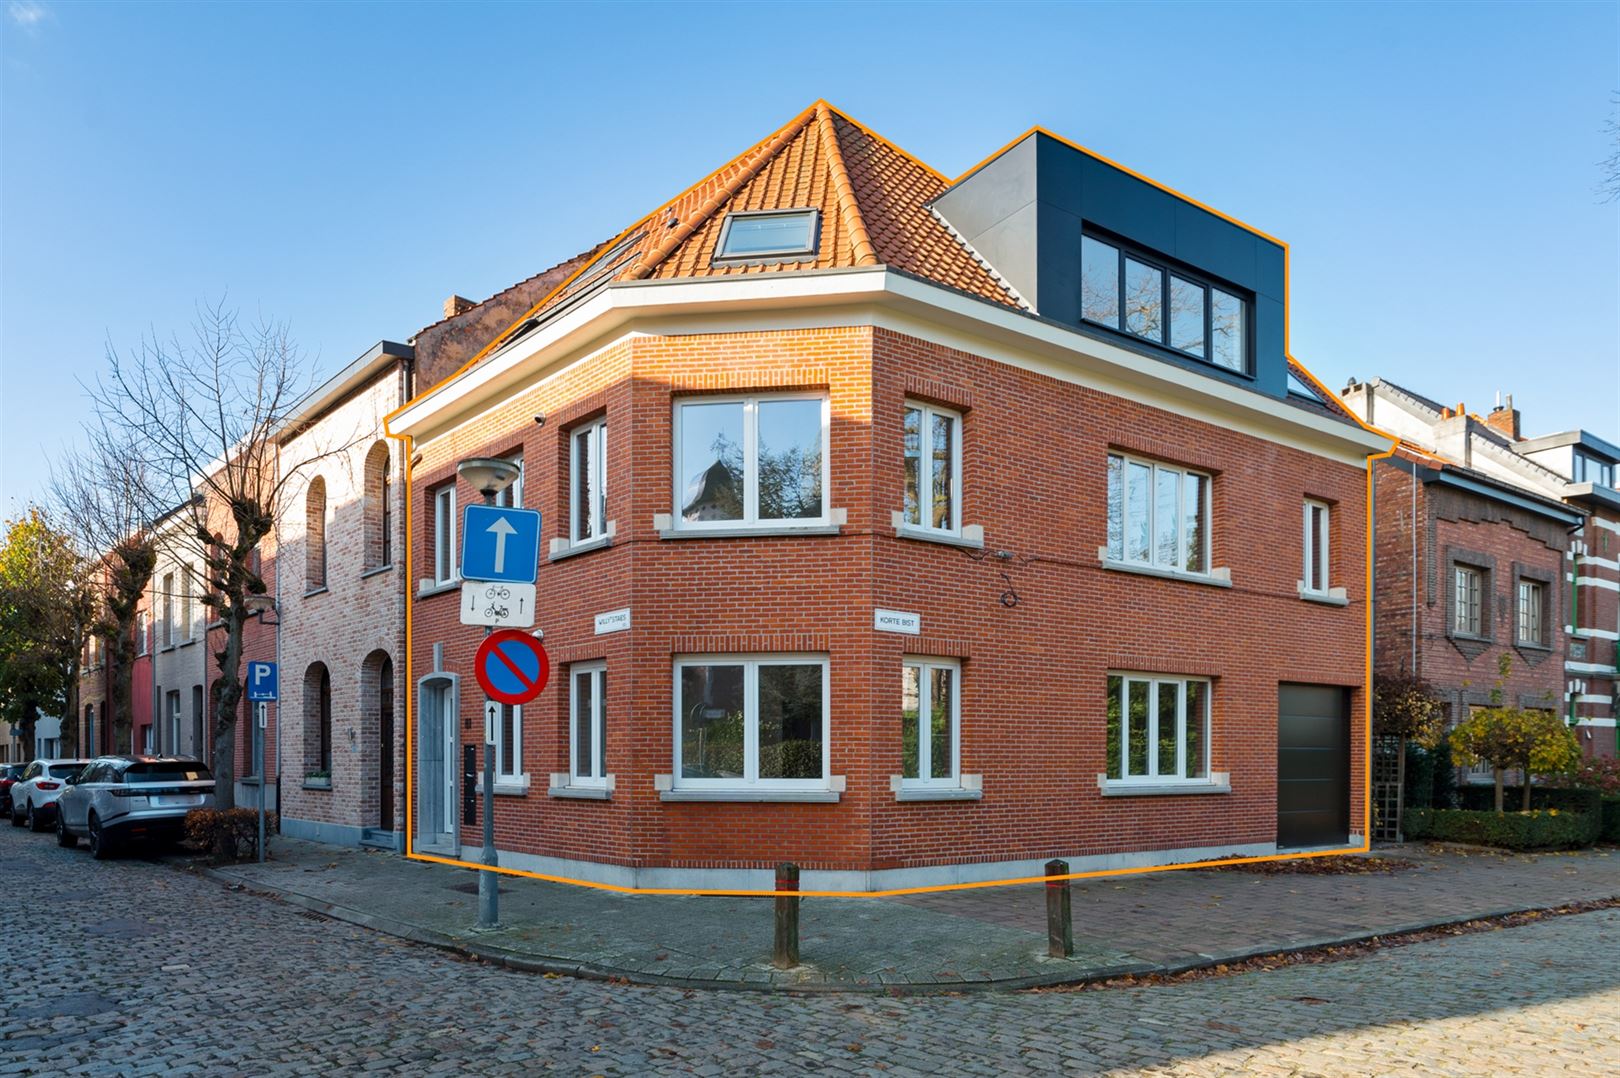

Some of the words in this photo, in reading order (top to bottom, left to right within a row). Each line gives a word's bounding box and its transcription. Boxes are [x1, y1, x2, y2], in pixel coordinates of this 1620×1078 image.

[880, 616, 900, 626] KORTE
[902, 619, 914, 627] BIST
[255, 664, 271, 685] P
